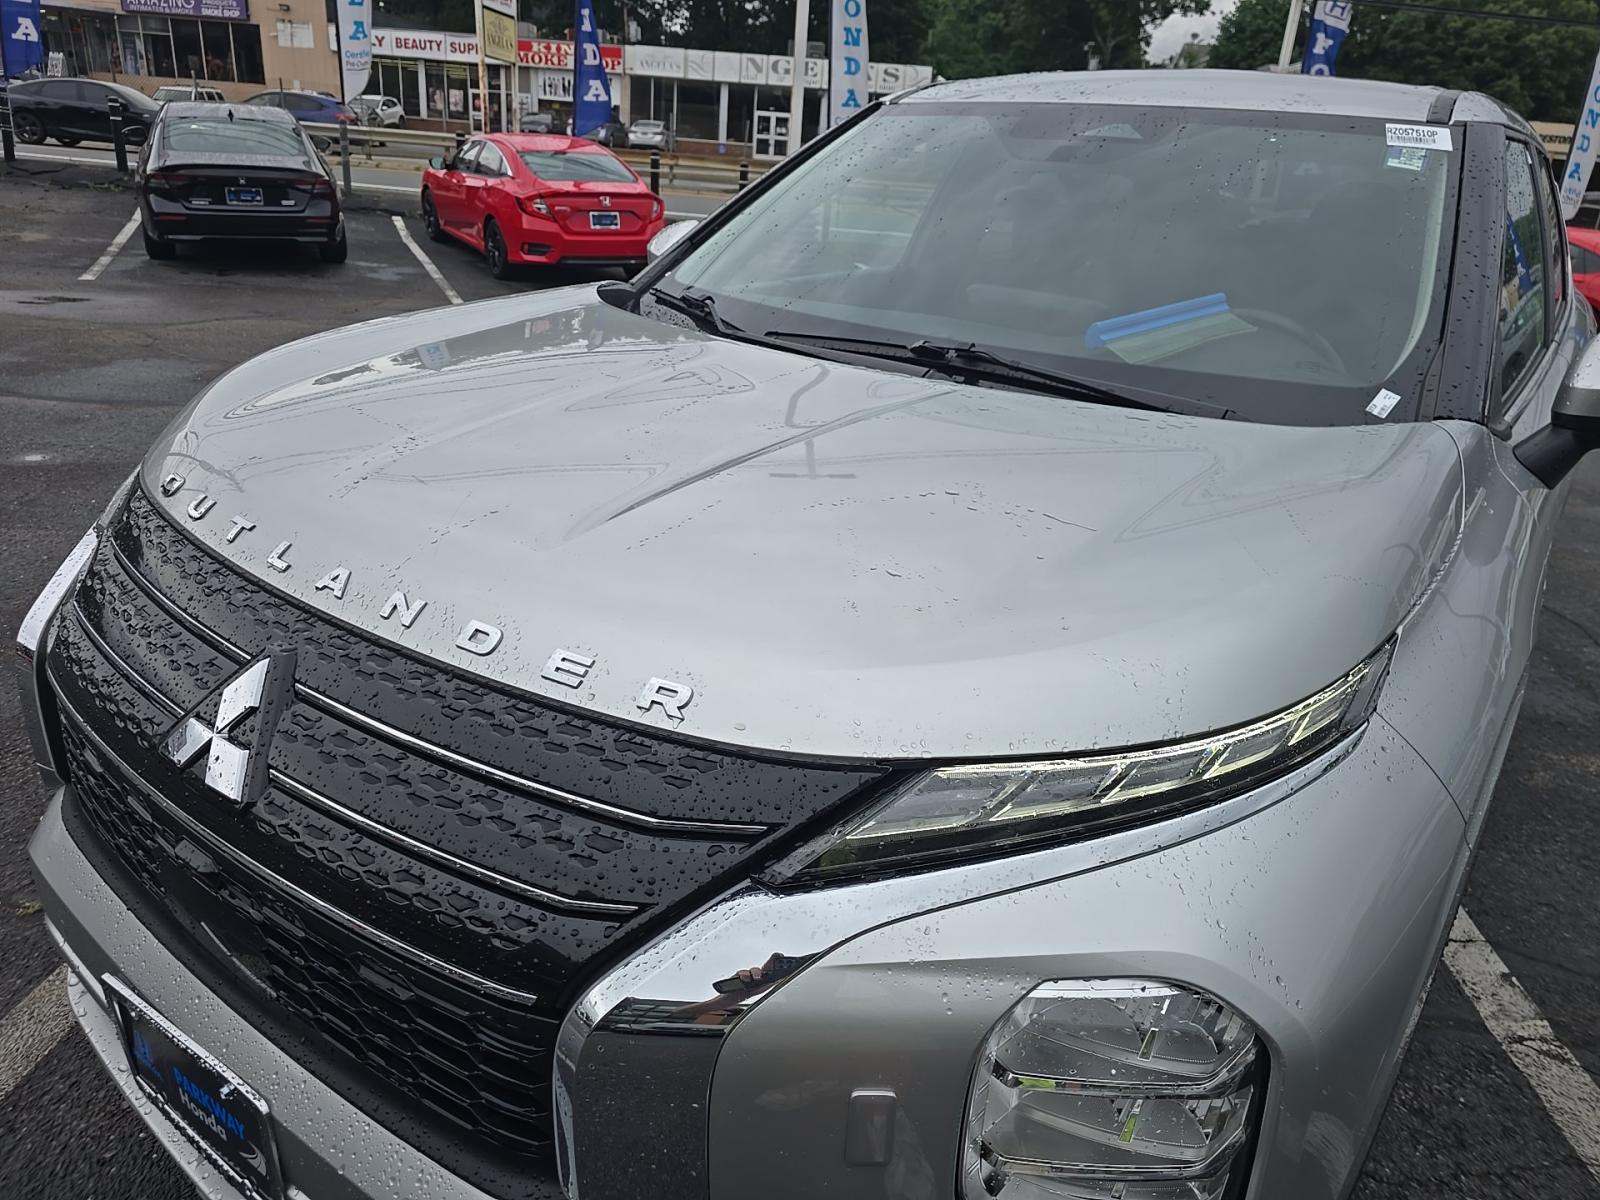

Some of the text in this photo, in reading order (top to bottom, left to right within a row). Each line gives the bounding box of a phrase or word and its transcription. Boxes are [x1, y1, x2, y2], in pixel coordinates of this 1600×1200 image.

[395, 37, 442, 51] BEAUTY
[160, 471, 694, 722] OUTLANDER
[171, 1065, 246, 1141] PARKWAY
[178, 1086, 229, 1143] Honda
